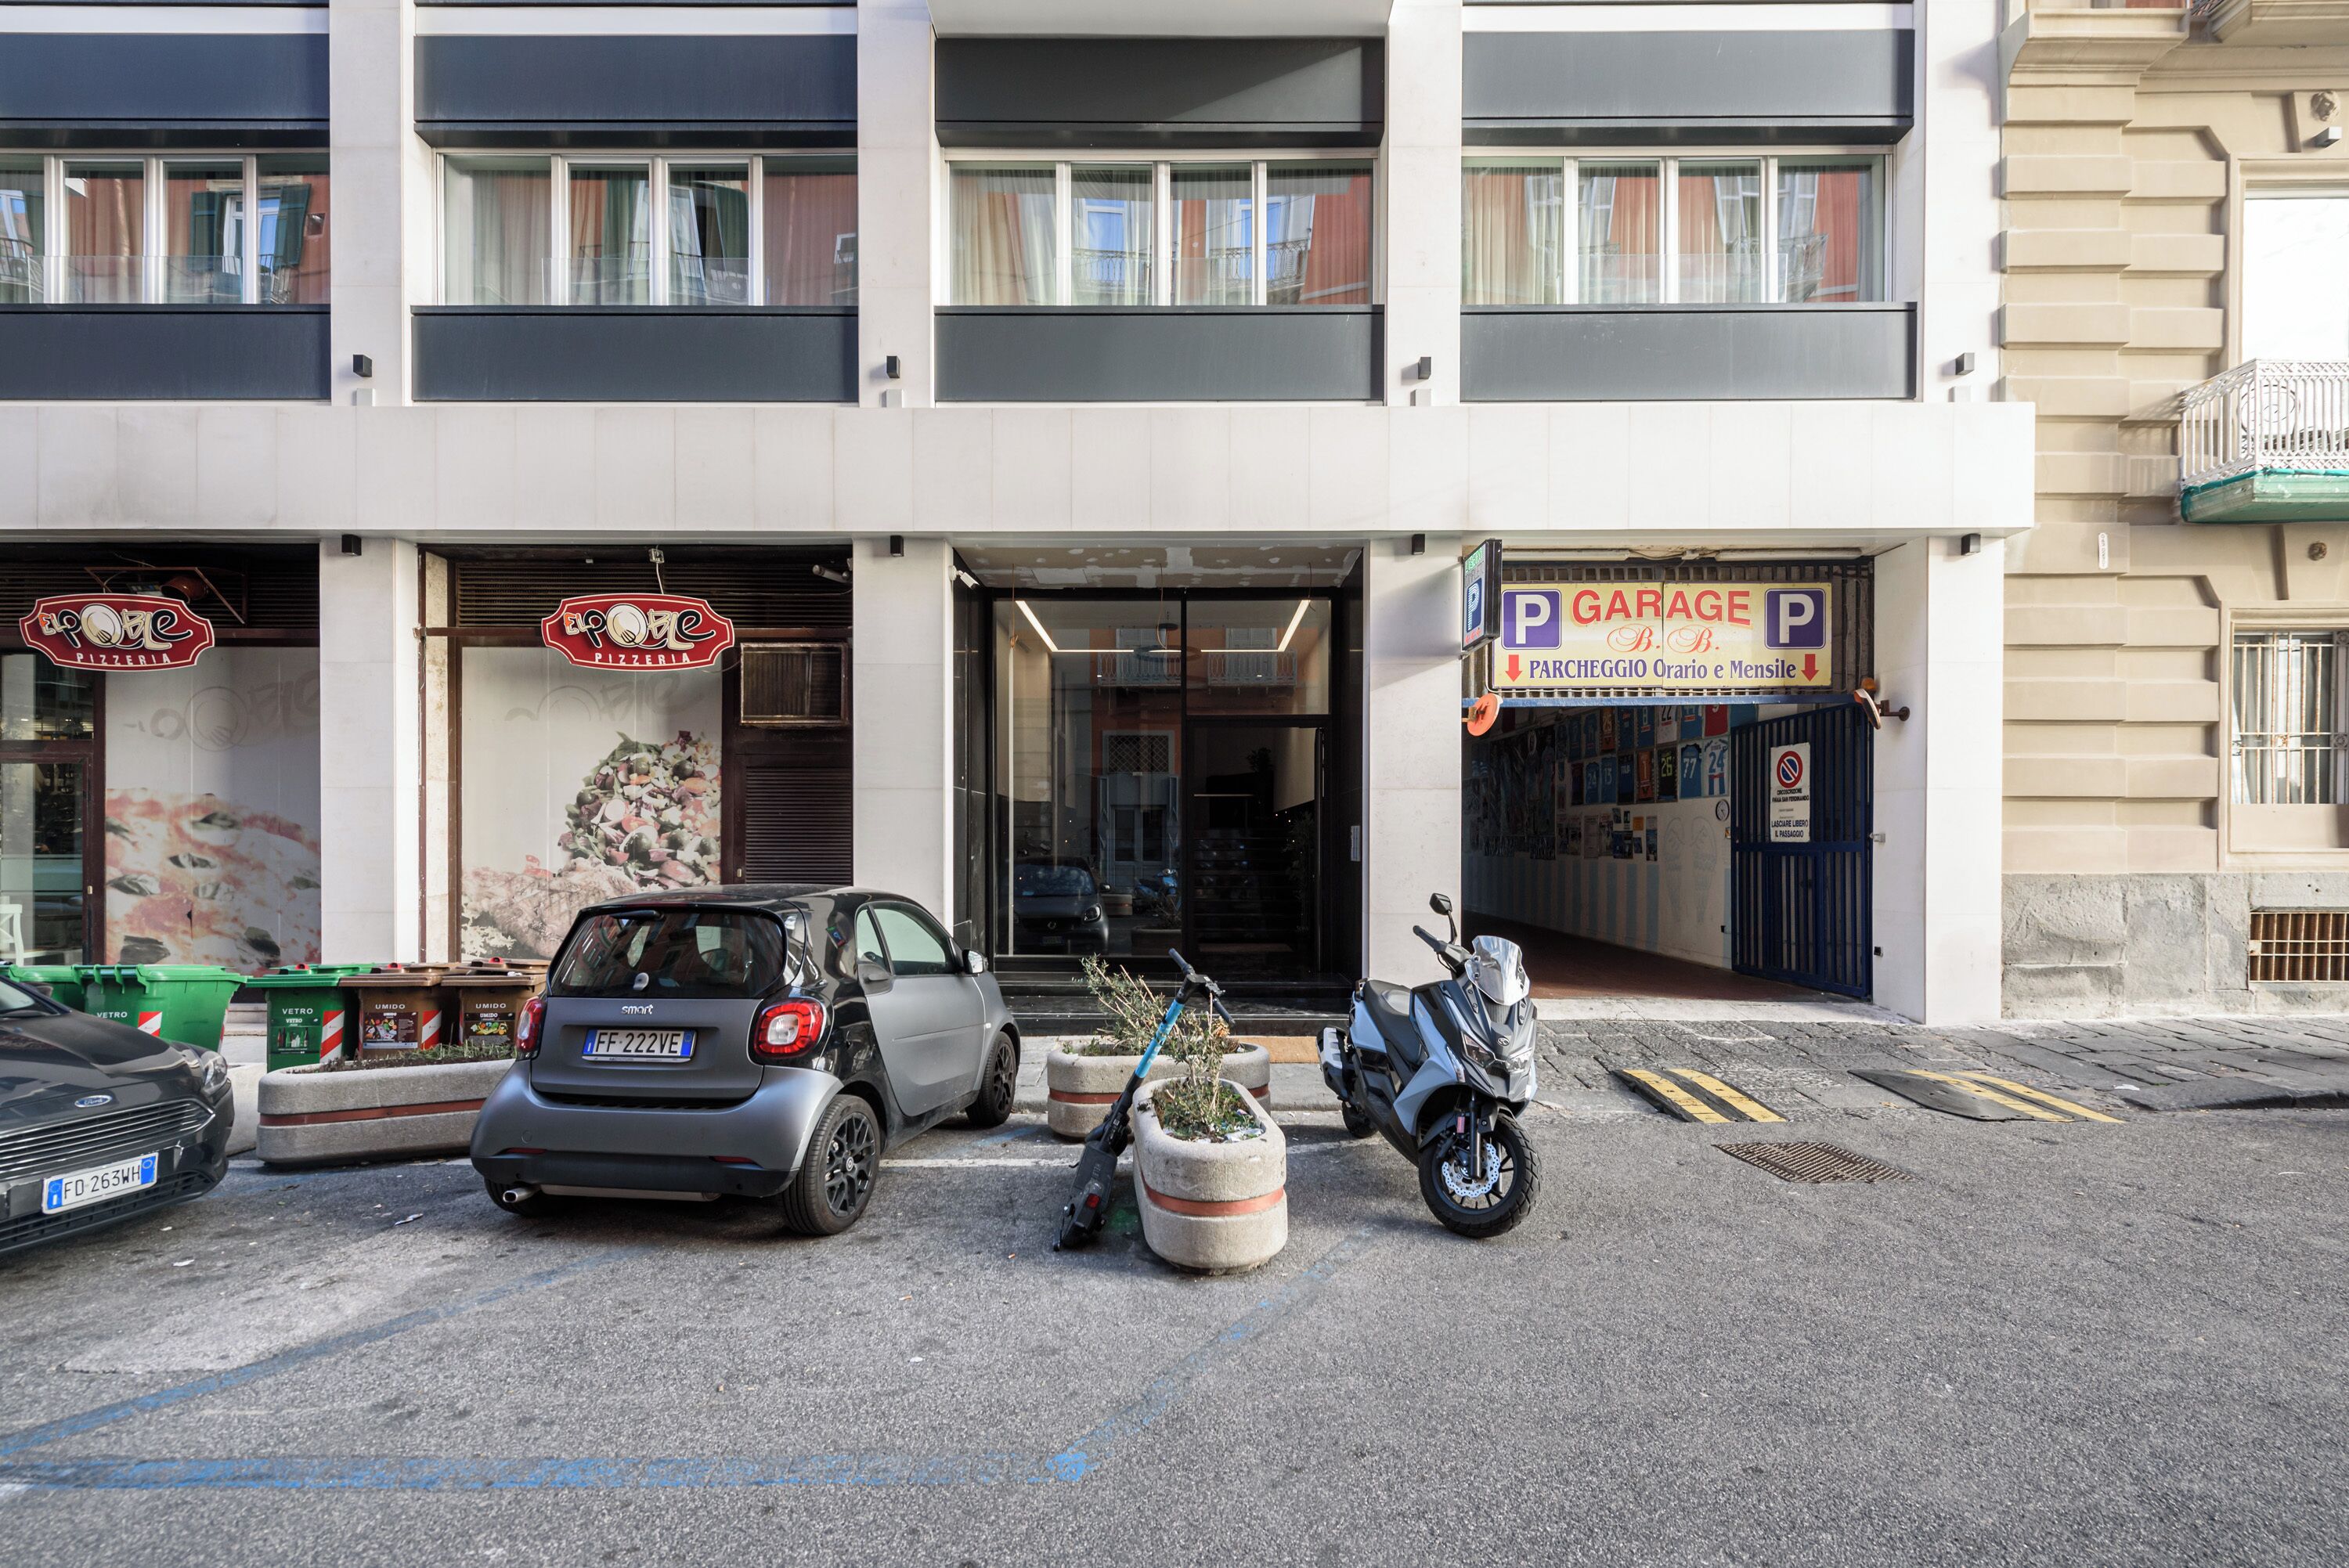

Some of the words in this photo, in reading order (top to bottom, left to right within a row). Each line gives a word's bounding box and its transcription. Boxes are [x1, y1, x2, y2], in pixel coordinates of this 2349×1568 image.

[1468, 582, 1480, 631] P
[1572, 589, 1751, 625] GARAGE
[38, 612, 70, 636] EL
[563, 612, 594, 636] EL
[1516, 594, 1551, 644] P
[1779, 593, 1815, 643] P
[77, 652, 171, 665] PIZZERIA
[595, 652, 691, 665] PIZZERIA
[1529, 658, 1647, 678] PARCHEGGIO
[1653, 658, 1708, 679] Orario
[1713, 665, 1724, 679] e
[1730, 658, 1796, 678] Mensile
[1661, 755, 1672, 777] 26
[1683, 758, 1697, 778] 77
[1709, 752, 1726, 773] 24
[1792, 819, 1809, 827] LIBERO
[622, 1004, 654, 1015] smart
[595, 1032, 619, 1053] FF
[622, 1032, 681, 1054] 222VE
[91, 1165, 141, 1193] 263WH
